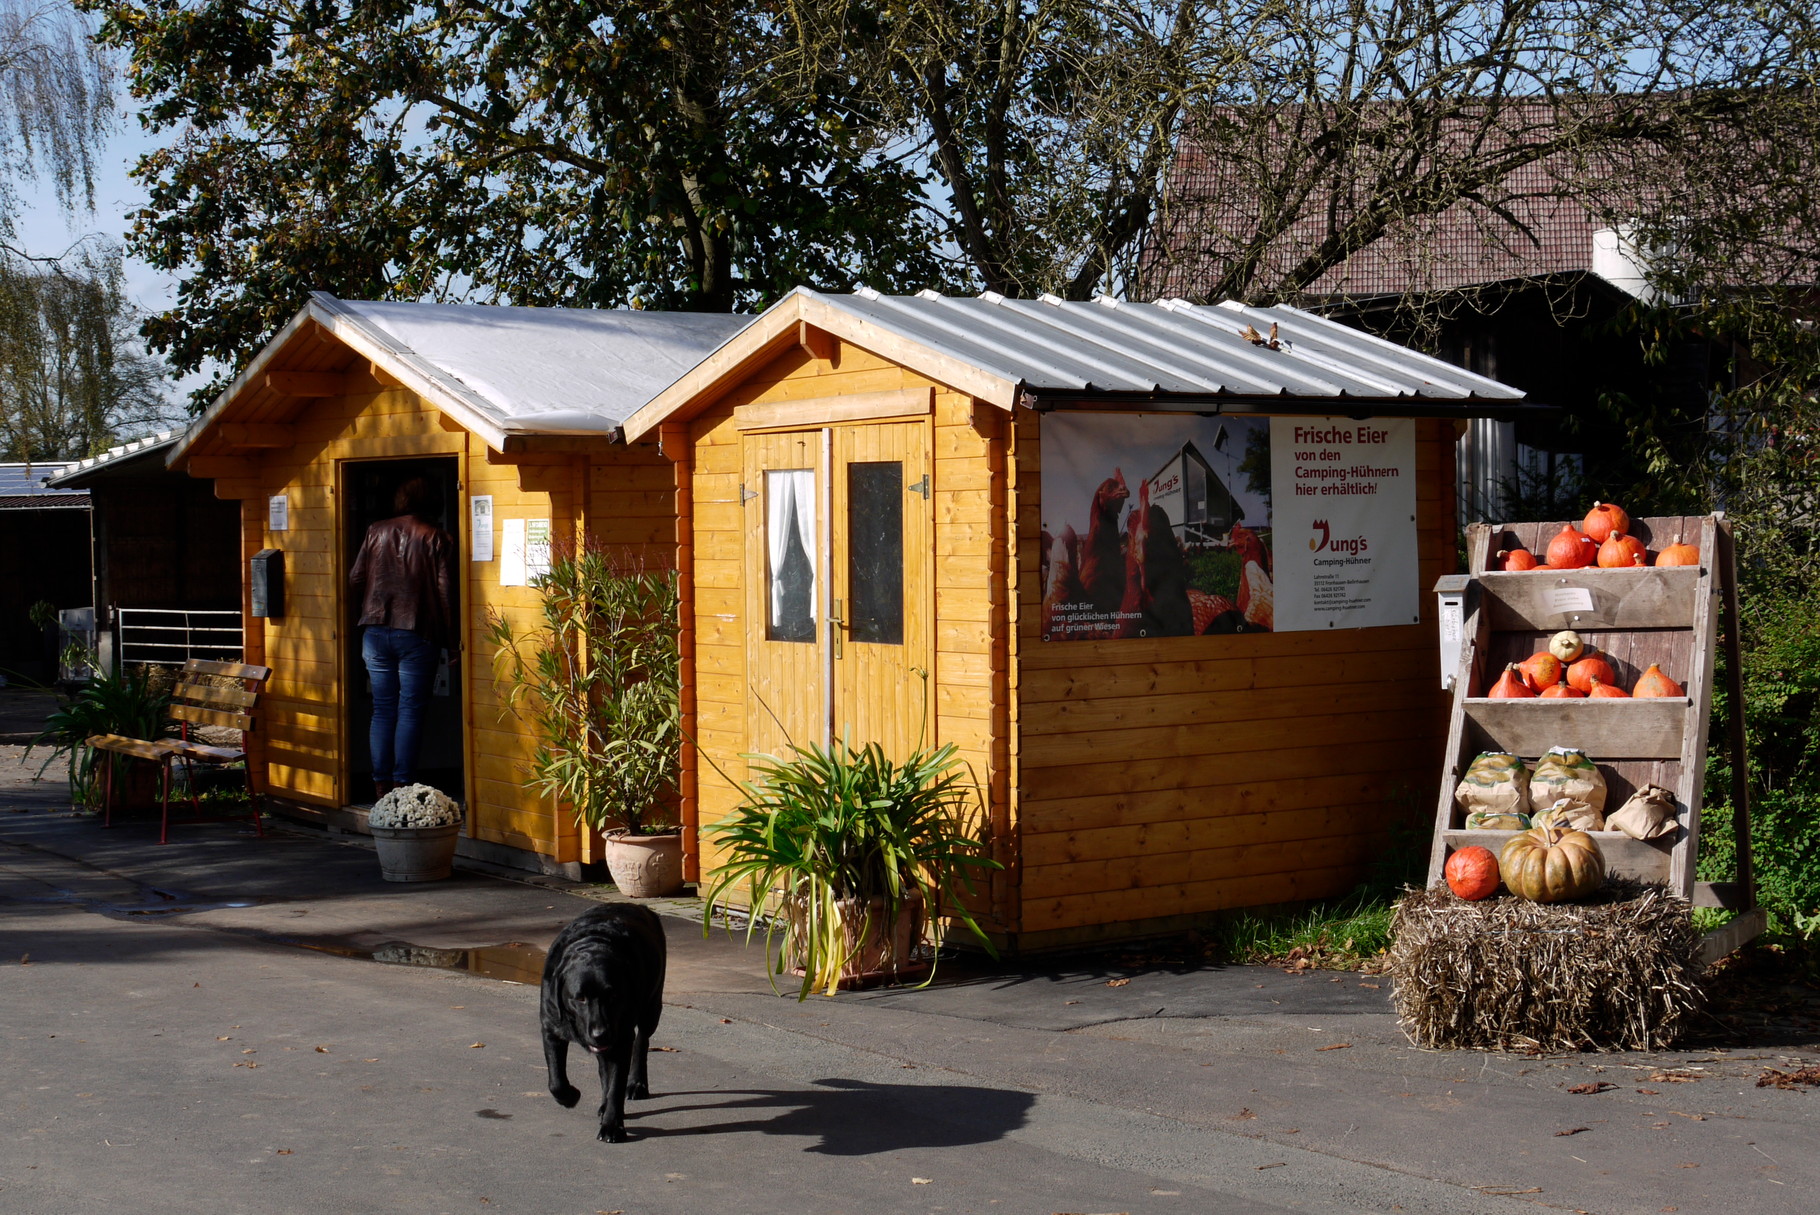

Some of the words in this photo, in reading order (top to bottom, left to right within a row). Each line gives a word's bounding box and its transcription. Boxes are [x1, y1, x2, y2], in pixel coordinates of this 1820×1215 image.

[1294, 426, 1353, 444] Frische
[1357, 426, 1389, 444] Eier
[1294, 451, 1316, 461] von
[1319, 448, 1341, 461] den
[1295, 465, 1399, 481] Camping-Hühnern
[1295, 483, 1318, 495] hier
[1321, 482, 1378, 495] erhältlich!
[1313, 557, 1371, 567] Camping-Hühner
[1051, 602, 1078, 611] Frische
[1079, 602, 1094, 610] Eier
[1051, 614, 1066, 622] von
[1067, 611, 1109, 623] glücklichen
[1110, 611, 1142, 620] Hühnern
[1051, 623, 1064, 632] auf
[1066, 624, 1093, 633] grünen
[1094, 622, 1120, 631] Wiesen
